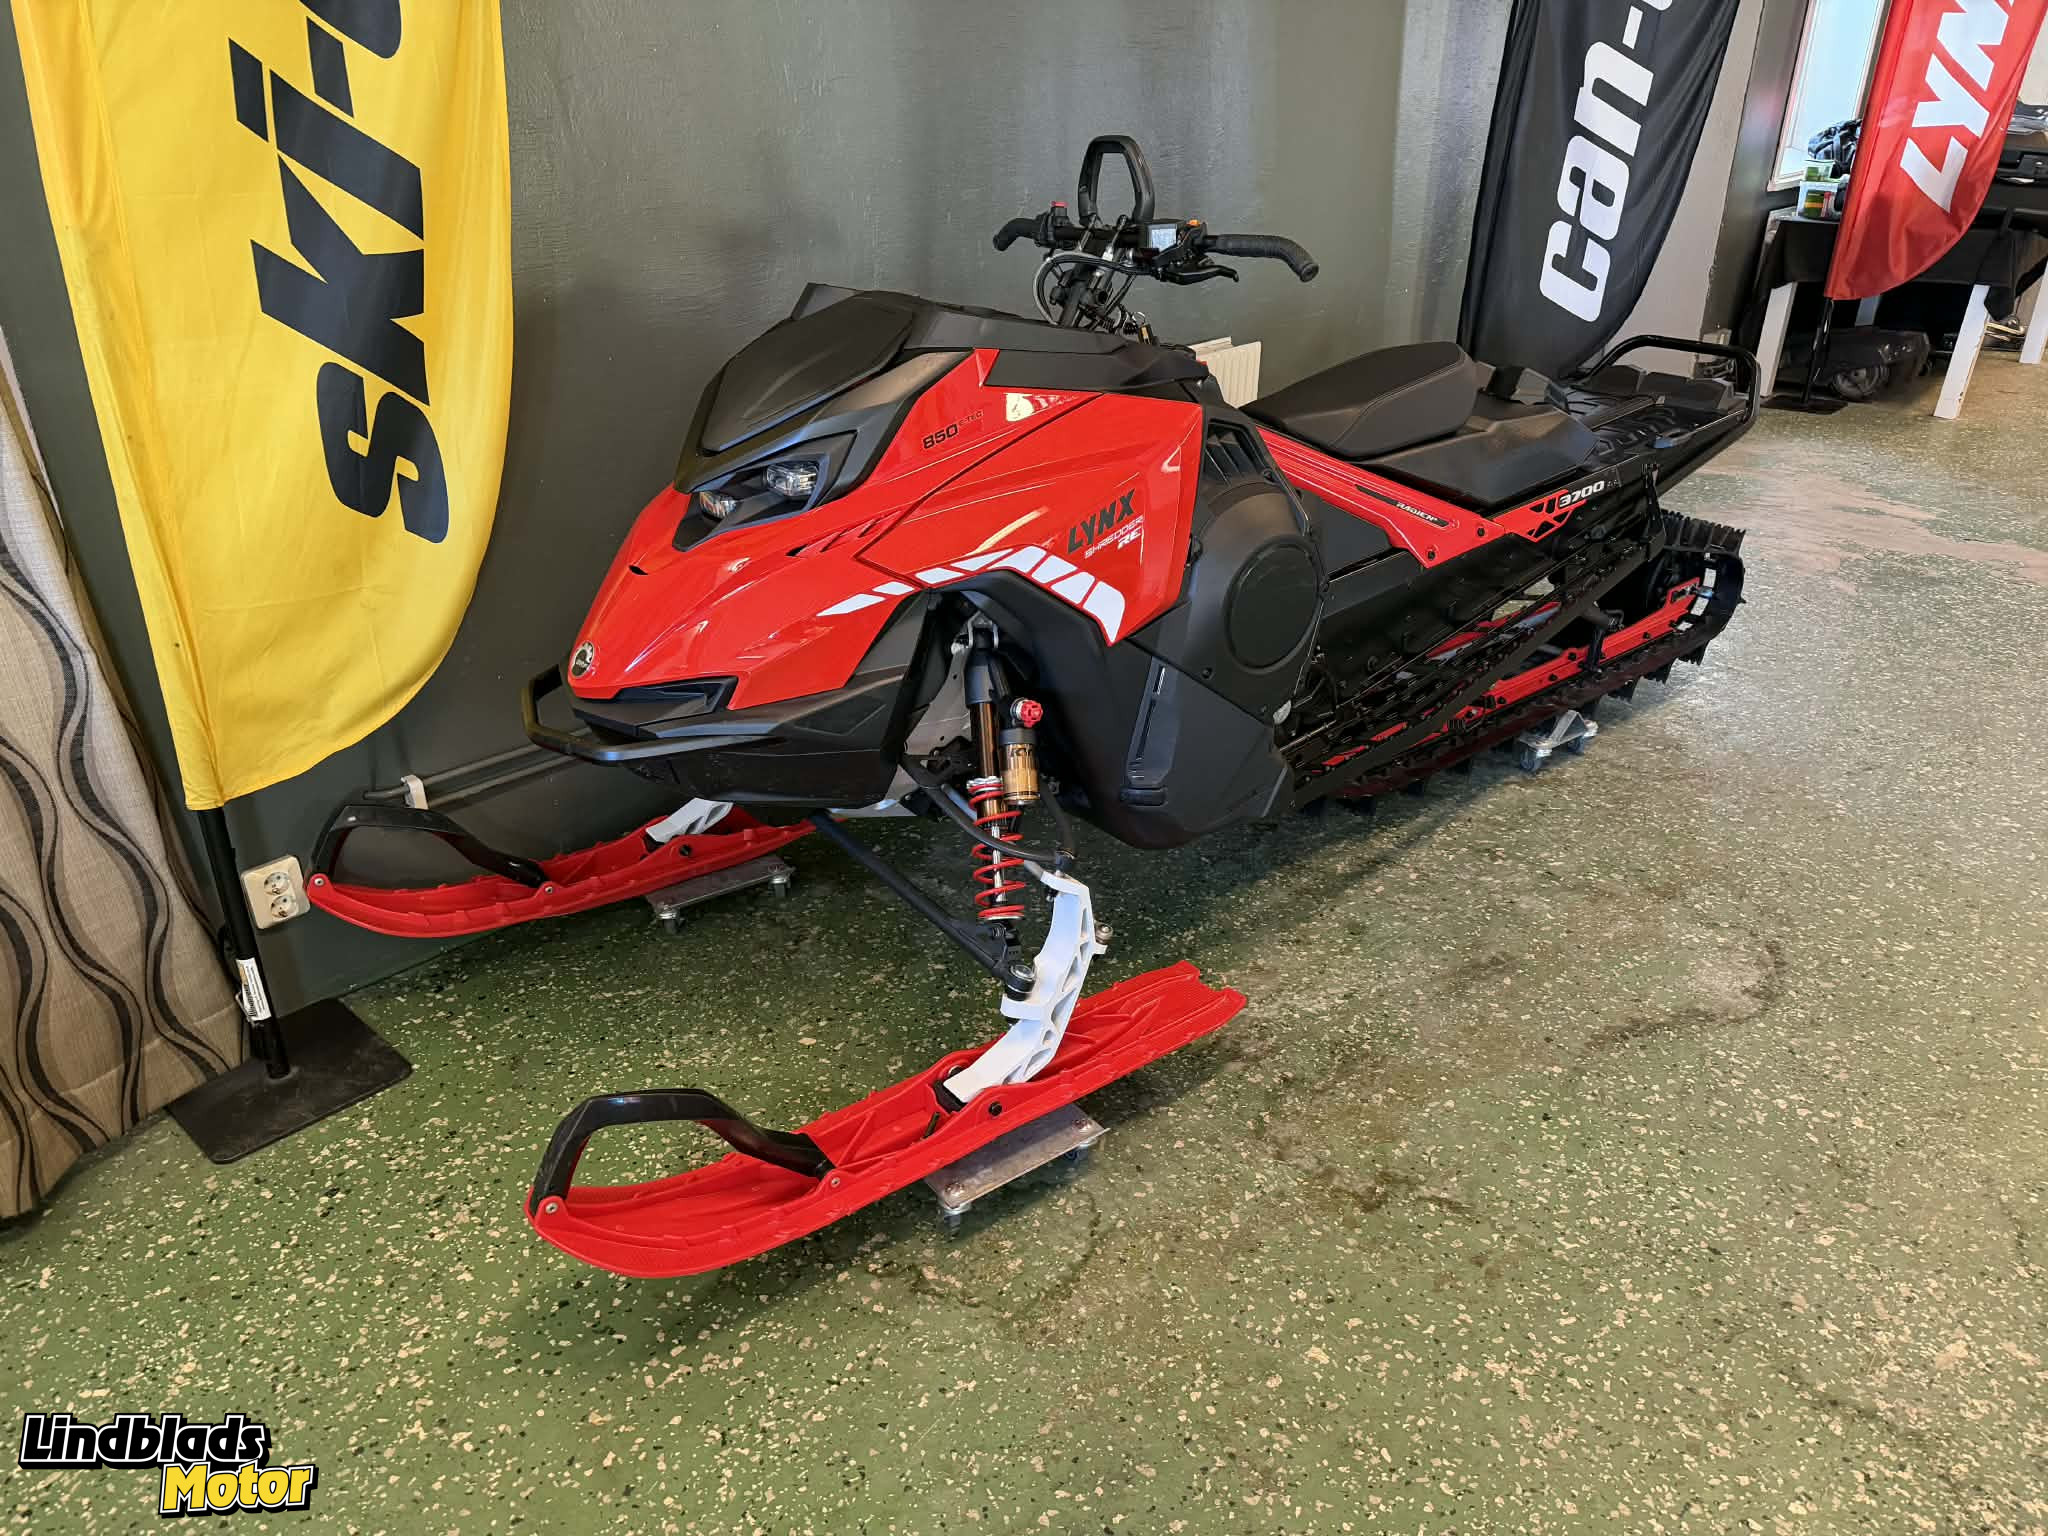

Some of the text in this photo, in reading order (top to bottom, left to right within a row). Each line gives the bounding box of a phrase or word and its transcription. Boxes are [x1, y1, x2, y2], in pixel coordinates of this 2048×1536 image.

[1539, 0, 1673, 323] can-
[922, 423, 959, 449] 850
[1559, 480, 1605, 508] 3700
[1067, 488, 1136, 554] LYNX
[1084, 514, 1145, 559] SHREDDER
[1117, 525, 1142, 550] RE
